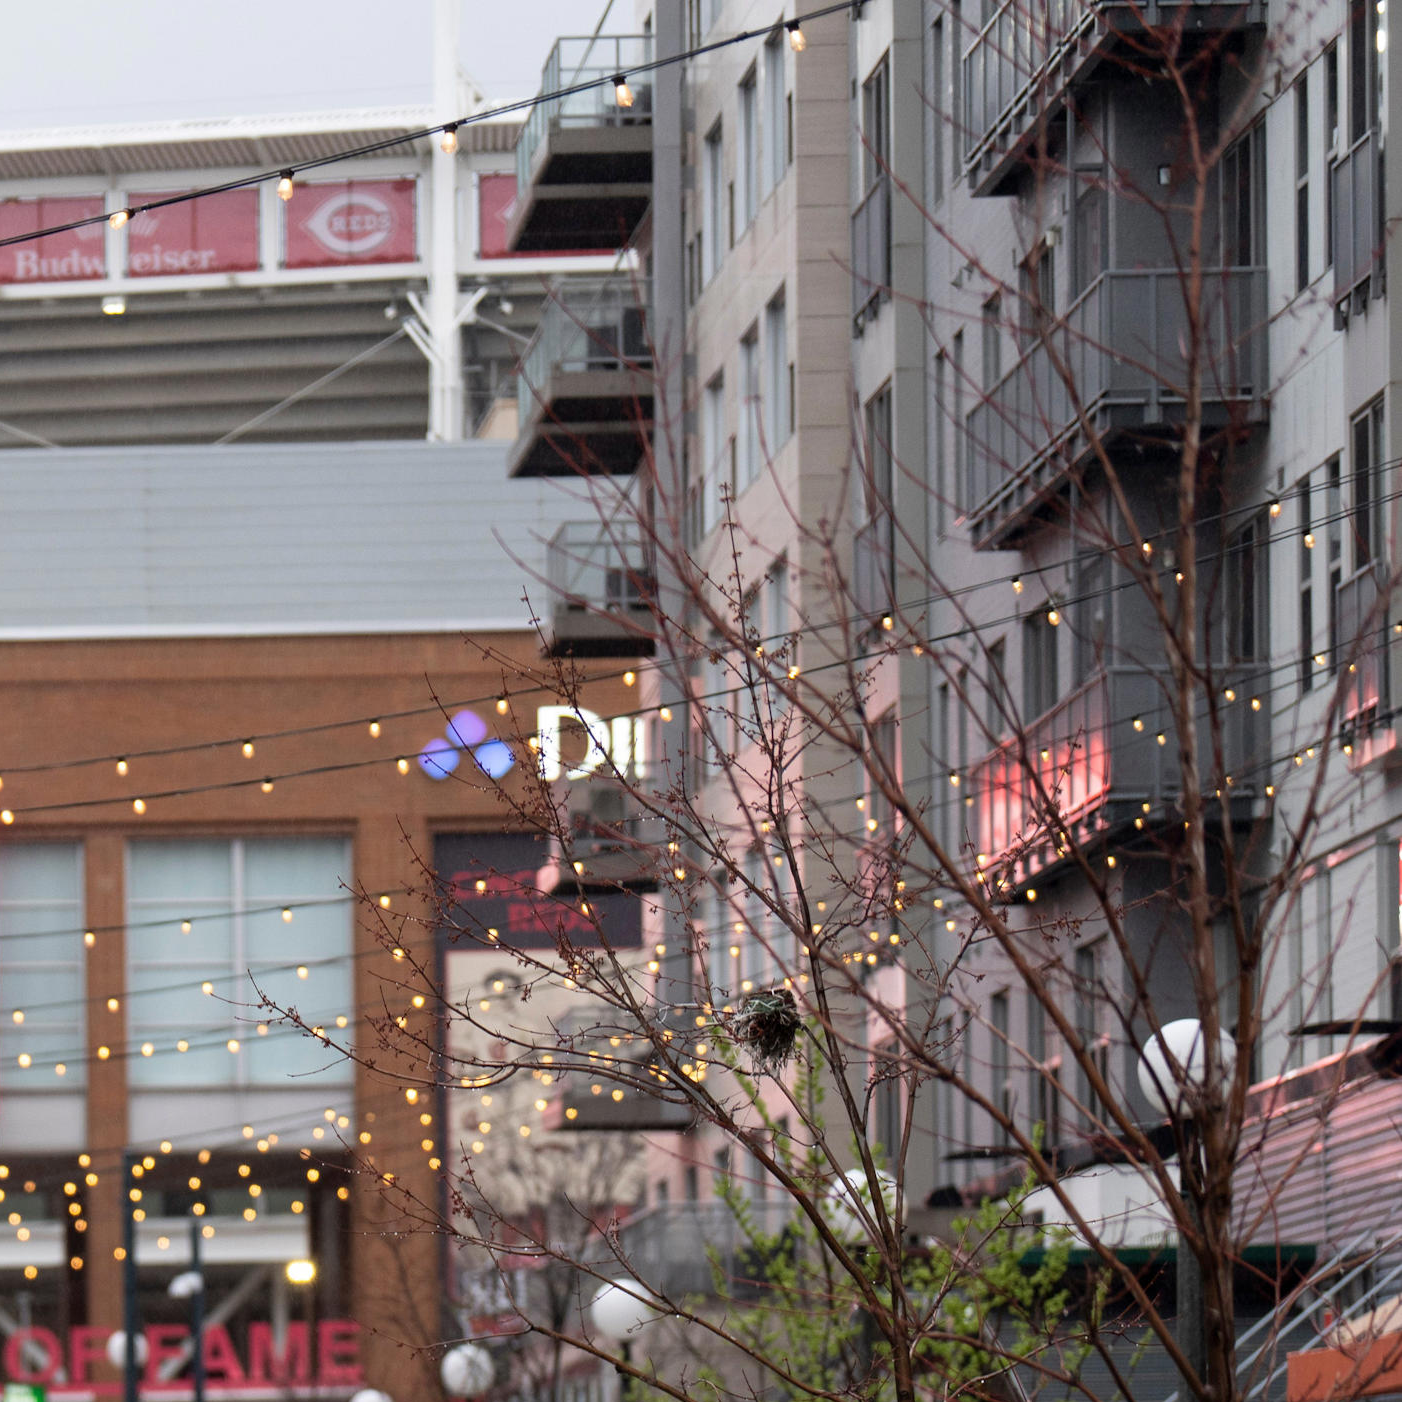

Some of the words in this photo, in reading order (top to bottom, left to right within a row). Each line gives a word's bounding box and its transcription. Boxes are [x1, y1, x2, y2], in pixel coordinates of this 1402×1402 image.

[330, 212, 392, 232] REDS
[14, 245, 216, 279] Budweiser
[3, 1324, 114, 1387] OF
[146, 1319, 364, 1386] FAME
